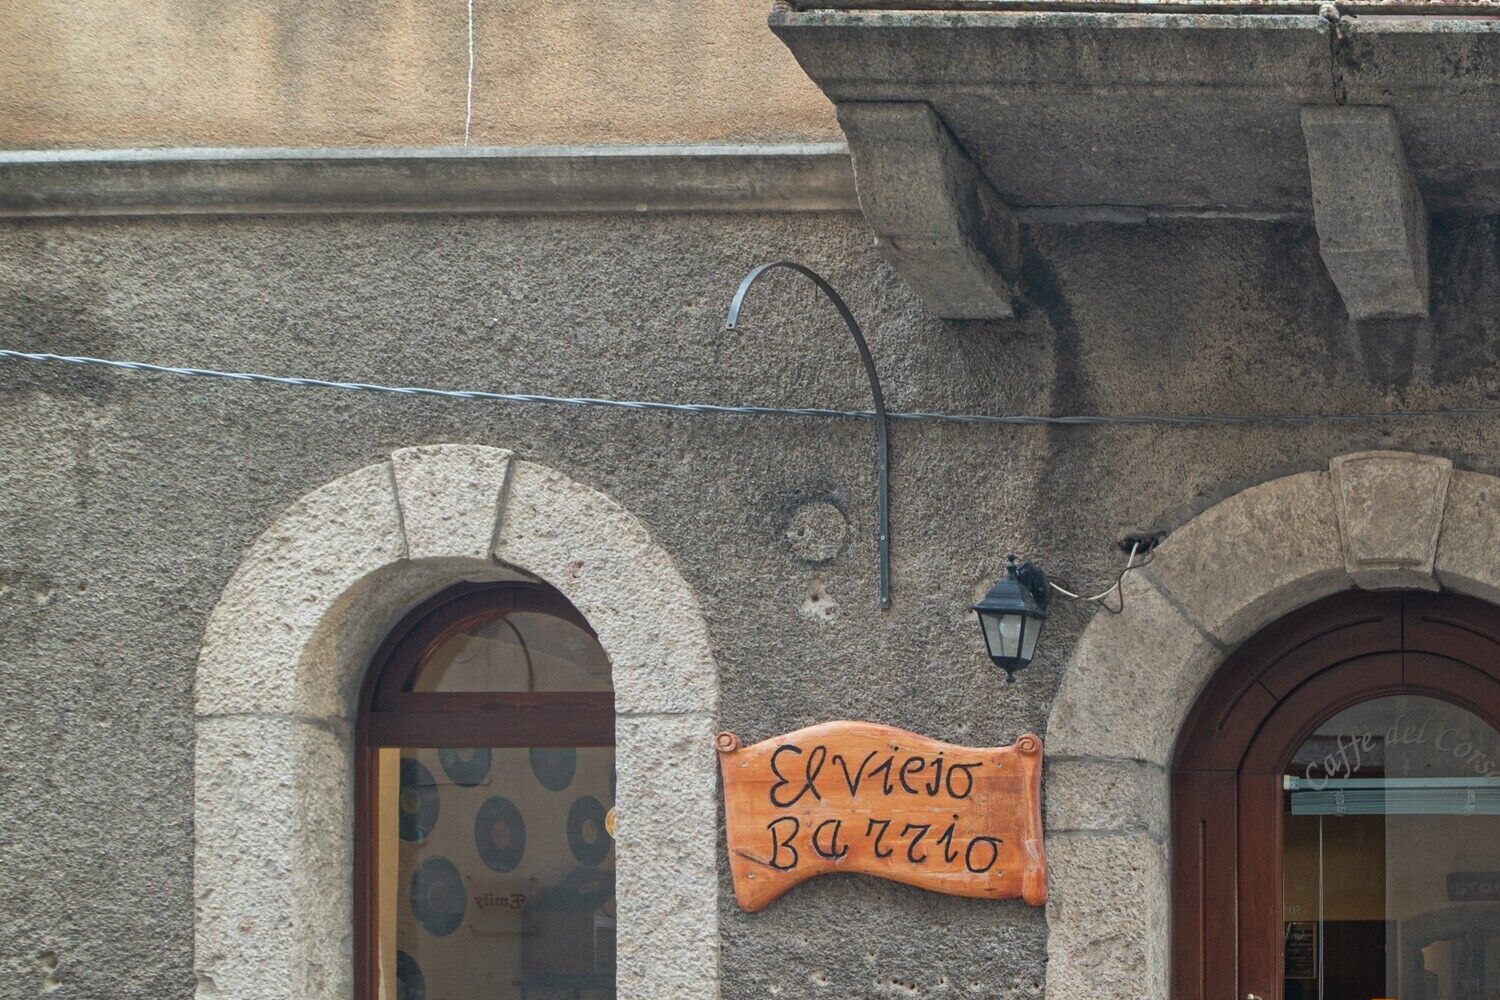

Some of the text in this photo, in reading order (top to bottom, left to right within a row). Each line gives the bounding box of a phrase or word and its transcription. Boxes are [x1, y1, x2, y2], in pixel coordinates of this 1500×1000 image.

[1385, 715, 1436, 746] del
[769, 744, 827, 808] El
[767, 813, 1003, 873] Barrio
